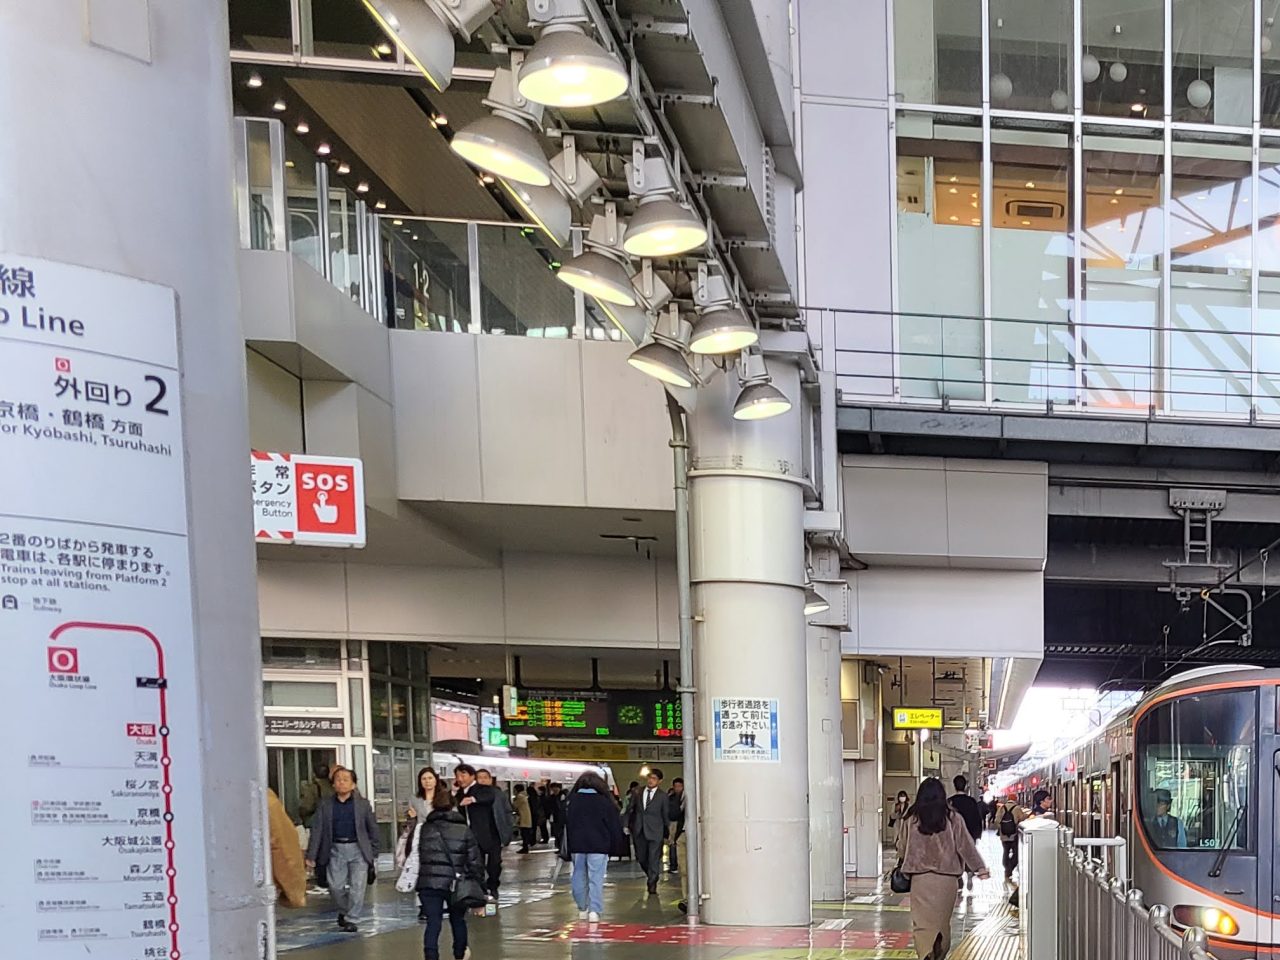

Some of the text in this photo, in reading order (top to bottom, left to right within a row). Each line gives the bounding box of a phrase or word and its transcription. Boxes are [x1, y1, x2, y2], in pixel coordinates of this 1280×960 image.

[0, 264, 36, 299] 線
[21, 305, 85, 338] Line
[54, 374, 169, 416] 外回り 2
[111, 419, 144, 437] 方面
[0, 423, 18, 434] or
[101, 434, 173, 457] Tsuruhashi
[301, 472, 349, 492] SOS
[254, 499, 292, 509] ergency
[262, 507, 293, 518] Button
[0, 532, 154, 560] 2番のりばから発車する
[0, 548, 171, 577] 電車は、各駅に停まります。
[1, 563, 168, 588] Trains leaving from Platform 2
[1, 575, 111, 592] stop at all stations.
[721, 700, 769, 710] 歩行者通路を
[721, 710, 770, 720] 通って前に
[129, 724, 154, 735] 大阪
[722, 720, 770, 730] お進み下さい。
[137, 808, 161, 818] 京橋
[101, 836, 163, 847] 大阪城公園
